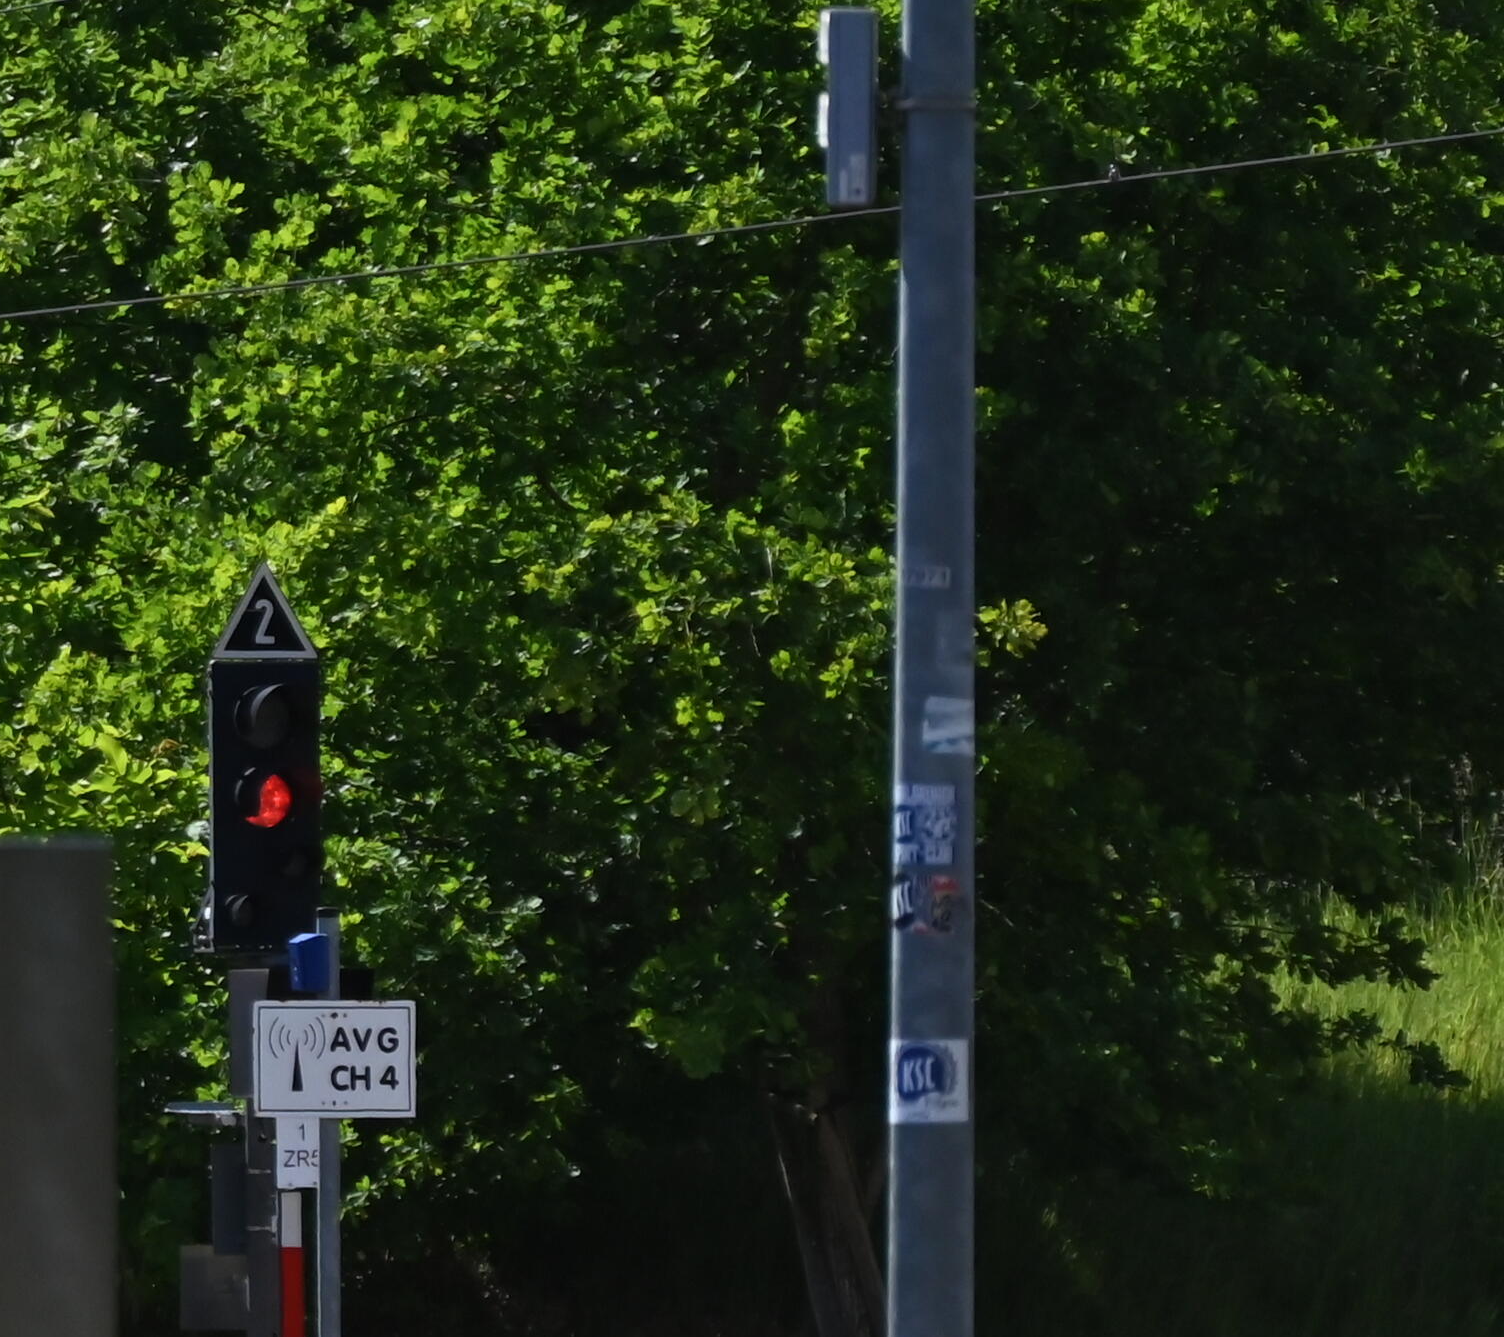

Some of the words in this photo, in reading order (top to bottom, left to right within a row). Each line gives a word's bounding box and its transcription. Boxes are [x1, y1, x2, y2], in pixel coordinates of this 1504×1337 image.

[254, 599, 276, 646] 2
[329, 1026, 399, 1055] AVG
[330, 1064, 371, 1092] CH
[379, 1065, 400, 1091] 4
[298, 1123, 306, 1142] 1
